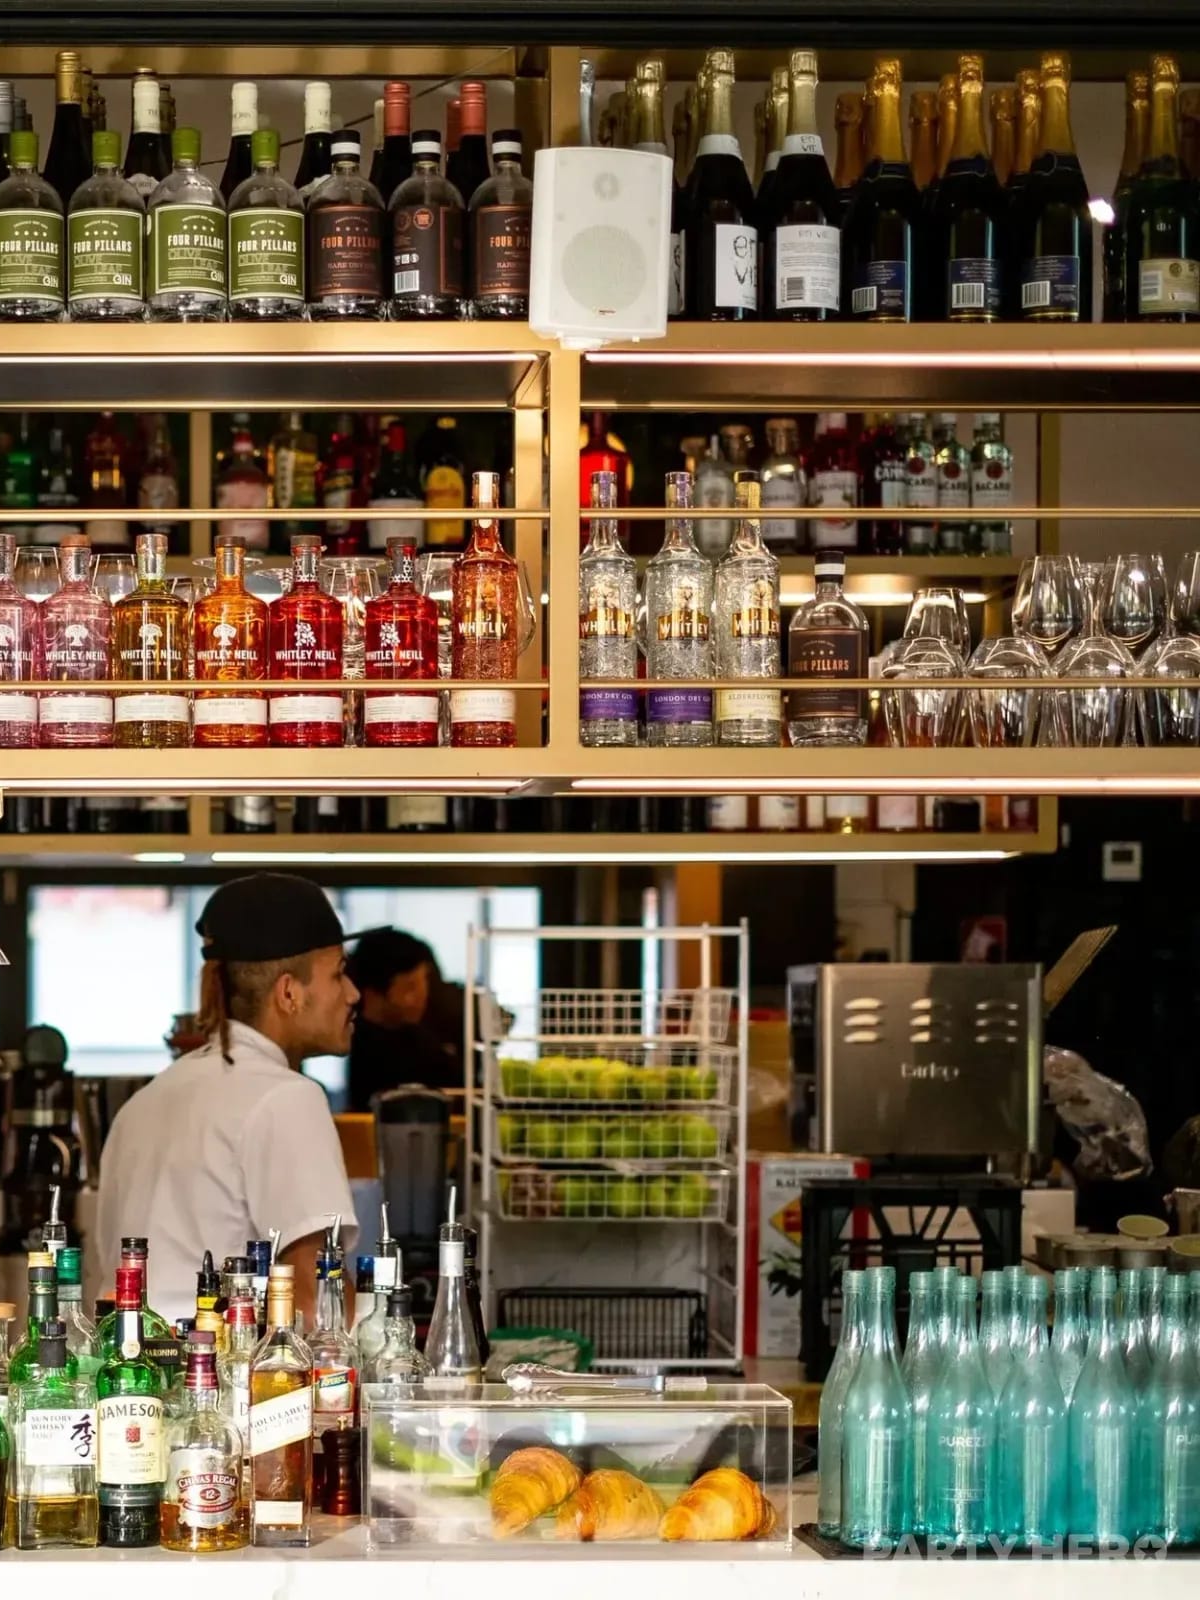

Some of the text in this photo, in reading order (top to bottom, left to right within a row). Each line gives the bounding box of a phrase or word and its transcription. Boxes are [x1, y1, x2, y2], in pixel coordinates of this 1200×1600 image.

[0, 240, 58, 254] FOUR PILLARS
[74, 239, 132, 254] FOUR PILLARS
[168, 234, 224, 250] FOUR PILLARS
[237, 239, 297, 252] FOUR PILLARS
[321, 236, 343, 249] FOUR
[490, 236, 513, 247] FOUR
[112, 273, 132, 286] GIN
[280, 274, 297, 286] GIN
[45, 650, 83, 661] WHITLEY
[120, 649, 157, 660] WHITLEY
[197, 650, 258, 660] WHITLEY NEILL
[275, 650, 336, 660] WHITLEY NEILL
[366, 650, 424, 660] WHITLEY NEILL
[811, 660, 849, 671] PILLARS
[655, 695, 686, 703] LONDON
[100, 1403, 161, 1420] JAMESON
[212, 1474, 237, 1487] REGAL
[205, 1489, 216, 1499] 12
